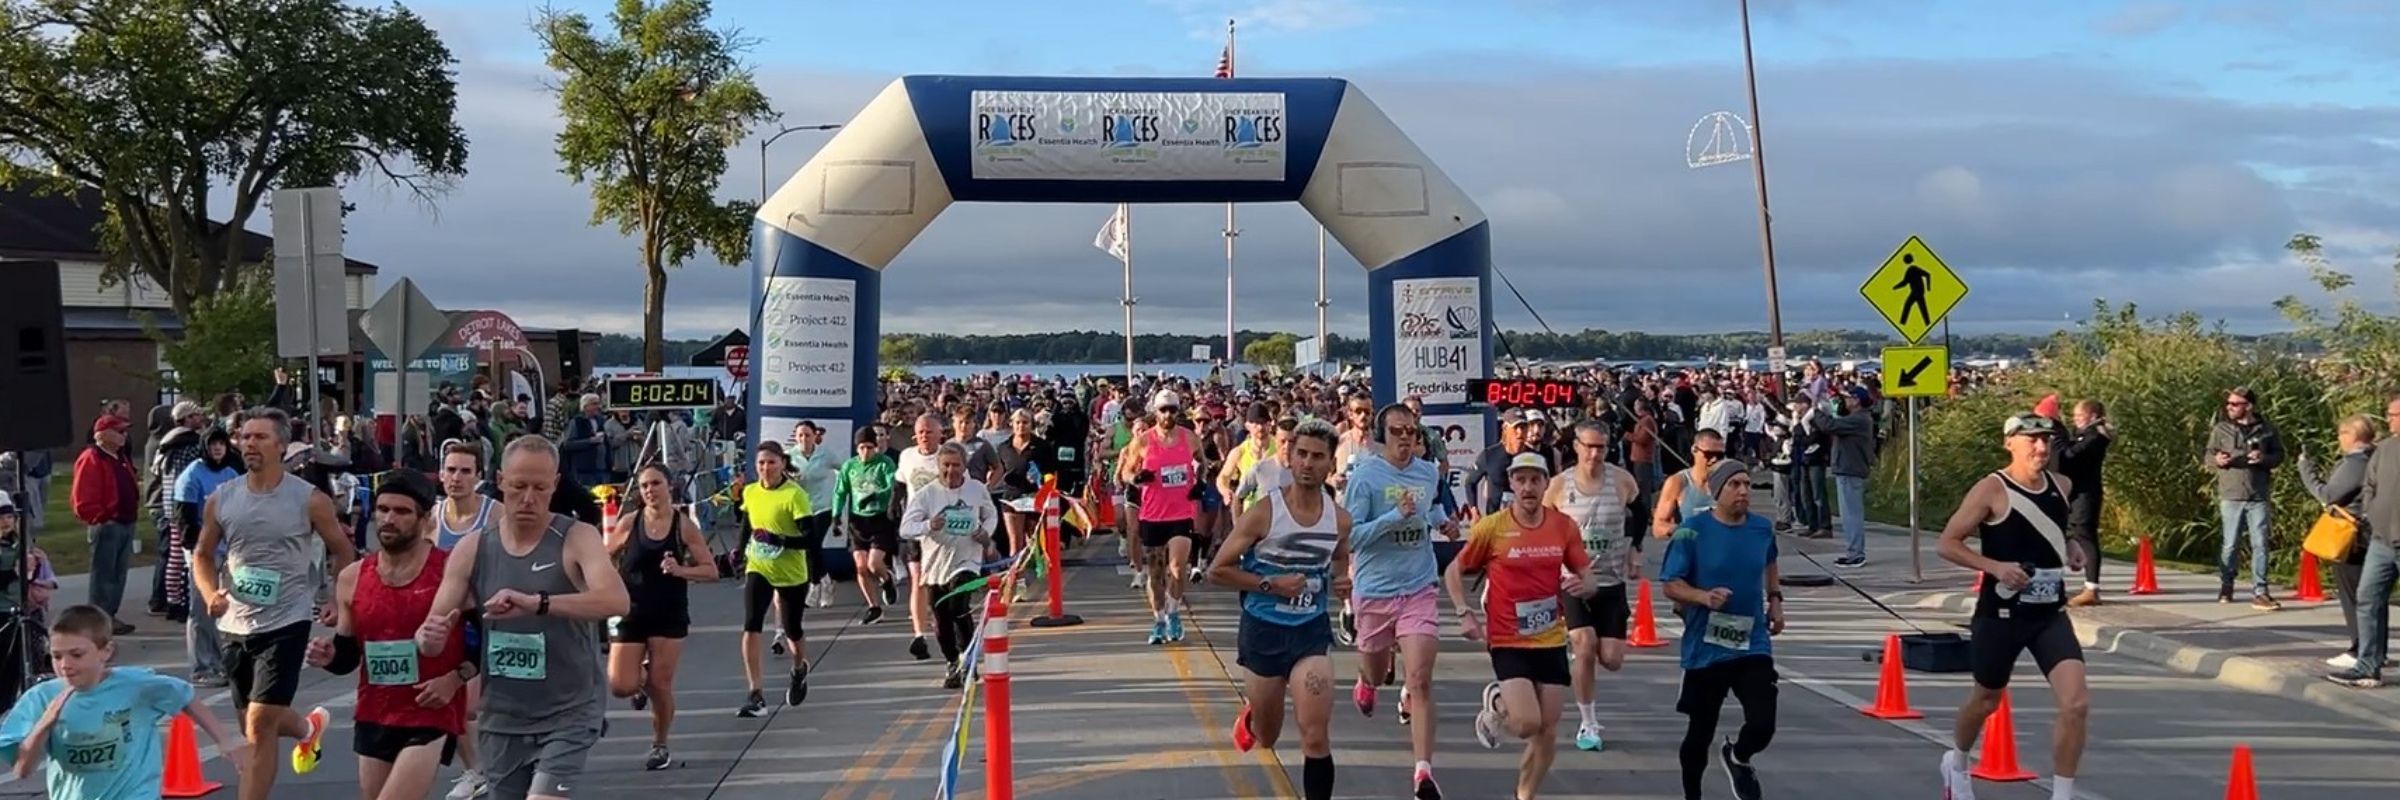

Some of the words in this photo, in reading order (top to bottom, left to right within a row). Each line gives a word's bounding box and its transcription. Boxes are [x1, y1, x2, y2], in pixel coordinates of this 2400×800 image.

[1072, 138, 1098, 146] Health
[1195, 139, 1221, 147] Health
[786, 293, 821, 302] Essentia
[823, 293, 850, 303] Health
[789, 314, 827, 327] Project
[829, 315, 848, 326] 412
[458, 317, 495, 340] DETROIT
[496, 318, 521, 340] LAKES
[784, 340, 820, 349] Essentia
[821, 340, 849, 350] Health
[425, 359, 440, 369] TO
[788, 361, 826, 374] Project
[828, 362, 846, 373] 412
[782, 386, 819, 396] Essentia
[820, 387, 848, 397] Health
[1407, 382, 1467, 394] Fredrikso
[1394, 528, 1422, 543] 1127
[237, 579, 273, 598] 2279
[1526, 610, 1552, 629] 590
[1713, 625, 1748, 643] 1005
[496, 650, 538, 669] 2290
[369, 658, 411, 676] 2004
[66, 743, 117, 766] 2027
